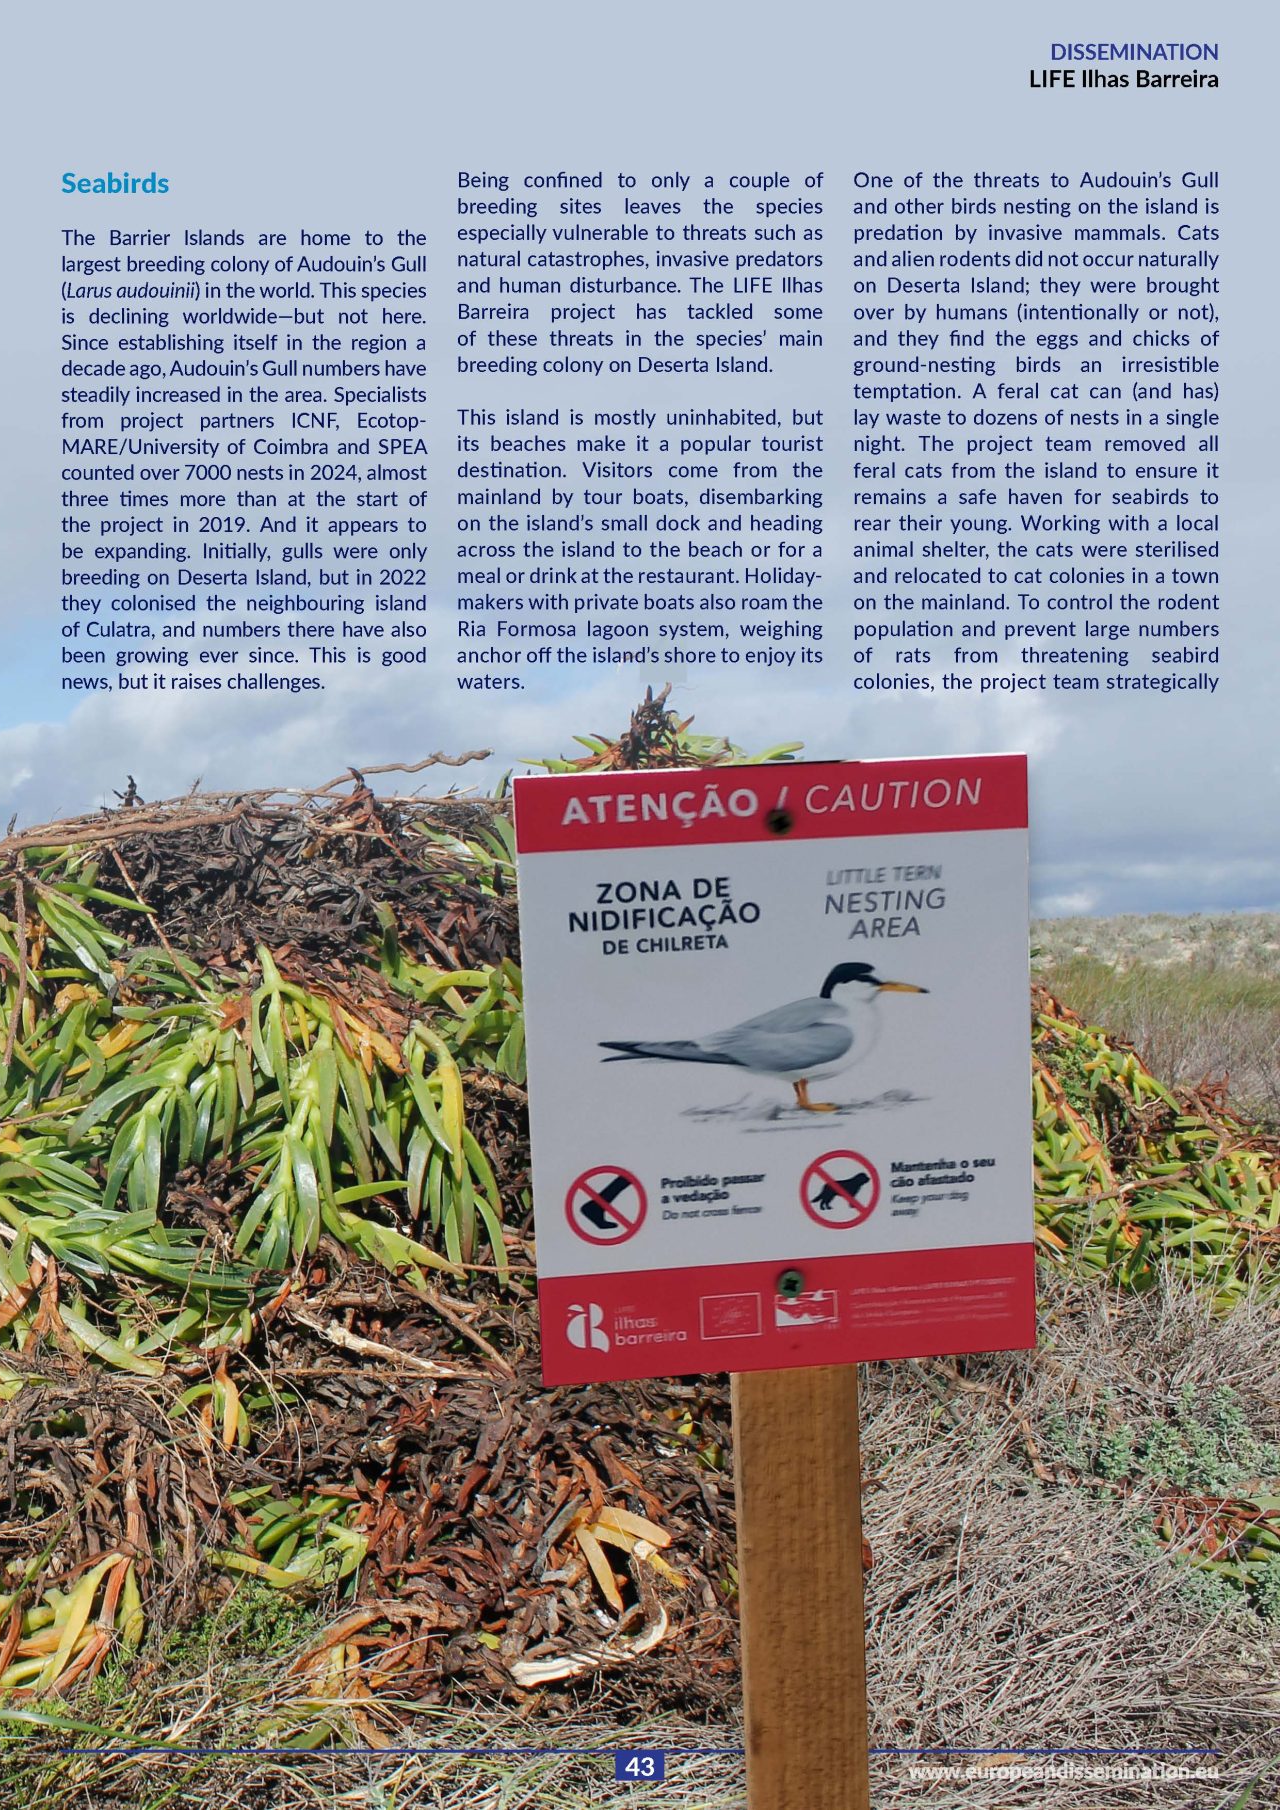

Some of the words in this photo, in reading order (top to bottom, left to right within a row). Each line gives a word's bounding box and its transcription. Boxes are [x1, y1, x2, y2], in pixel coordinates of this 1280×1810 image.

[562, 784, 759, 829] ATENÇÃO
[806, 777, 983, 814] CAUTION
[825, 867, 886, 886] LITTLE
[893, 864, 943, 882] TERN
[596, 880, 681, 904] ZONA
[693, 876, 731, 900] DE
[824, 887, 947, 915] NESTING
[568, 899, 761, 933] NIDIFICAÇÃO
[848, 916, 921, 940] AREA
[602, 940, 629, 956] DE
[635, 934, 729, 954] CHILRETA
[960, 1160, 969, 1169] o
[973, 1158, 996, 1168] seu
[661, 1174, 719, 1189] Proibido
[890, 1176, 915, 1188] cão
[661, 1195, 670, 1204] a
[614, 1316, 657, 1330] ilhas
[615, 1330, 688, 1346] barreira
